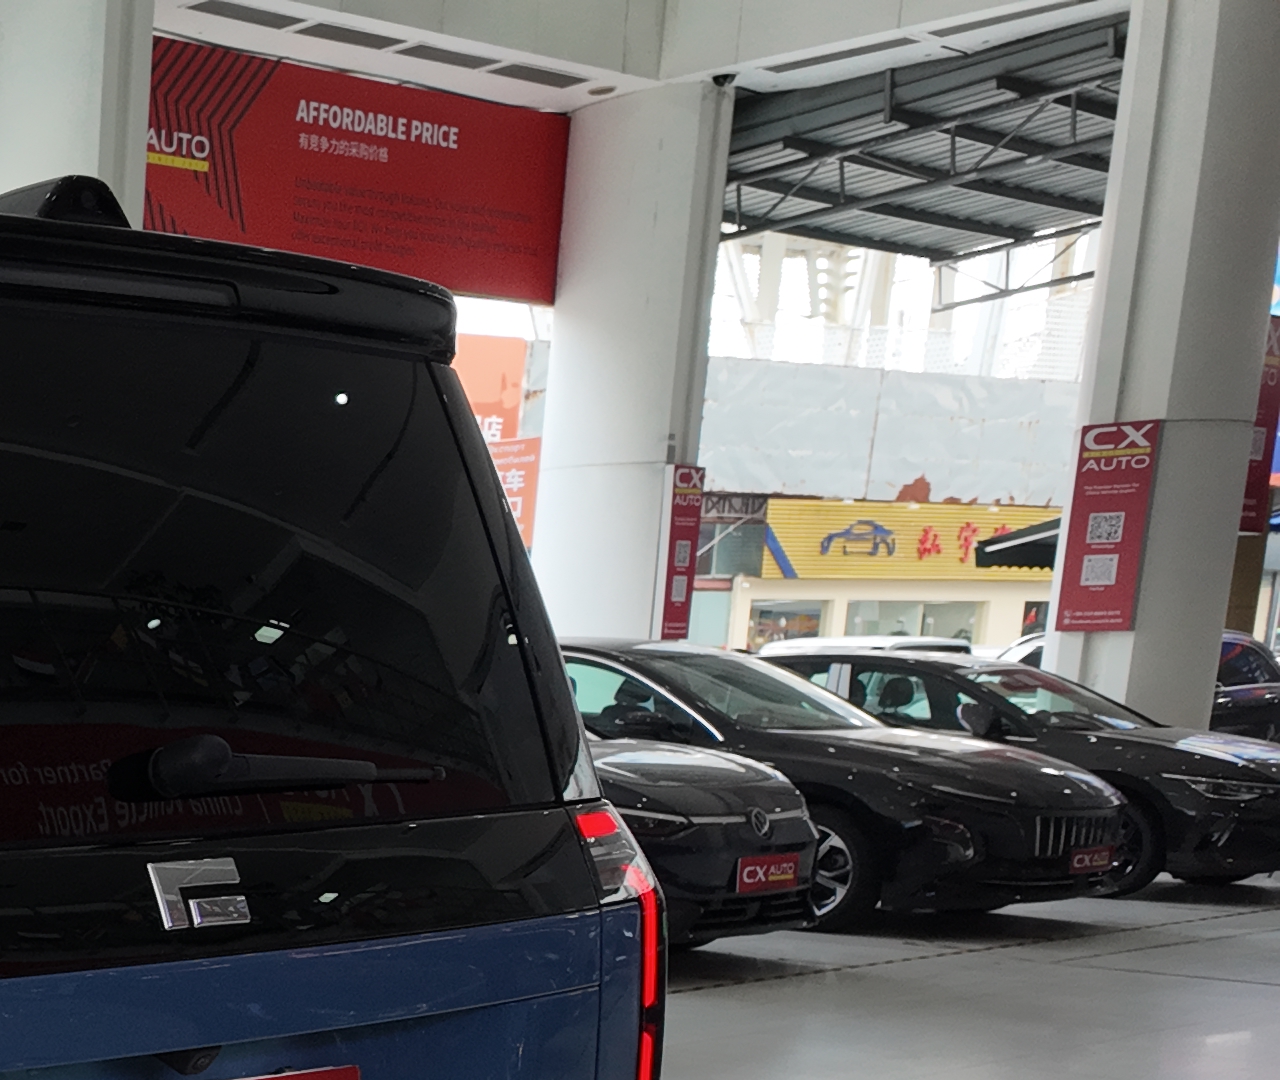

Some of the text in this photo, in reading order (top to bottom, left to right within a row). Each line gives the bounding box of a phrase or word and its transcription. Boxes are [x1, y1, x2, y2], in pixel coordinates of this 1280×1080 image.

[295, 98, 459, 150] AFFORDABLE PRICE
[146, 127, 210, 158] AUTO
[1265, 320, 1280, 356] X
[1084, 423, 1154, 450] CX
[1081, 455, 1150, 473] AUTO
[675, 468, 703, 488] CX
[674, 495, 702, 507] AUTO
[743, 864, 767, 883] CX
[768, 862, 795, 875] AUTO
